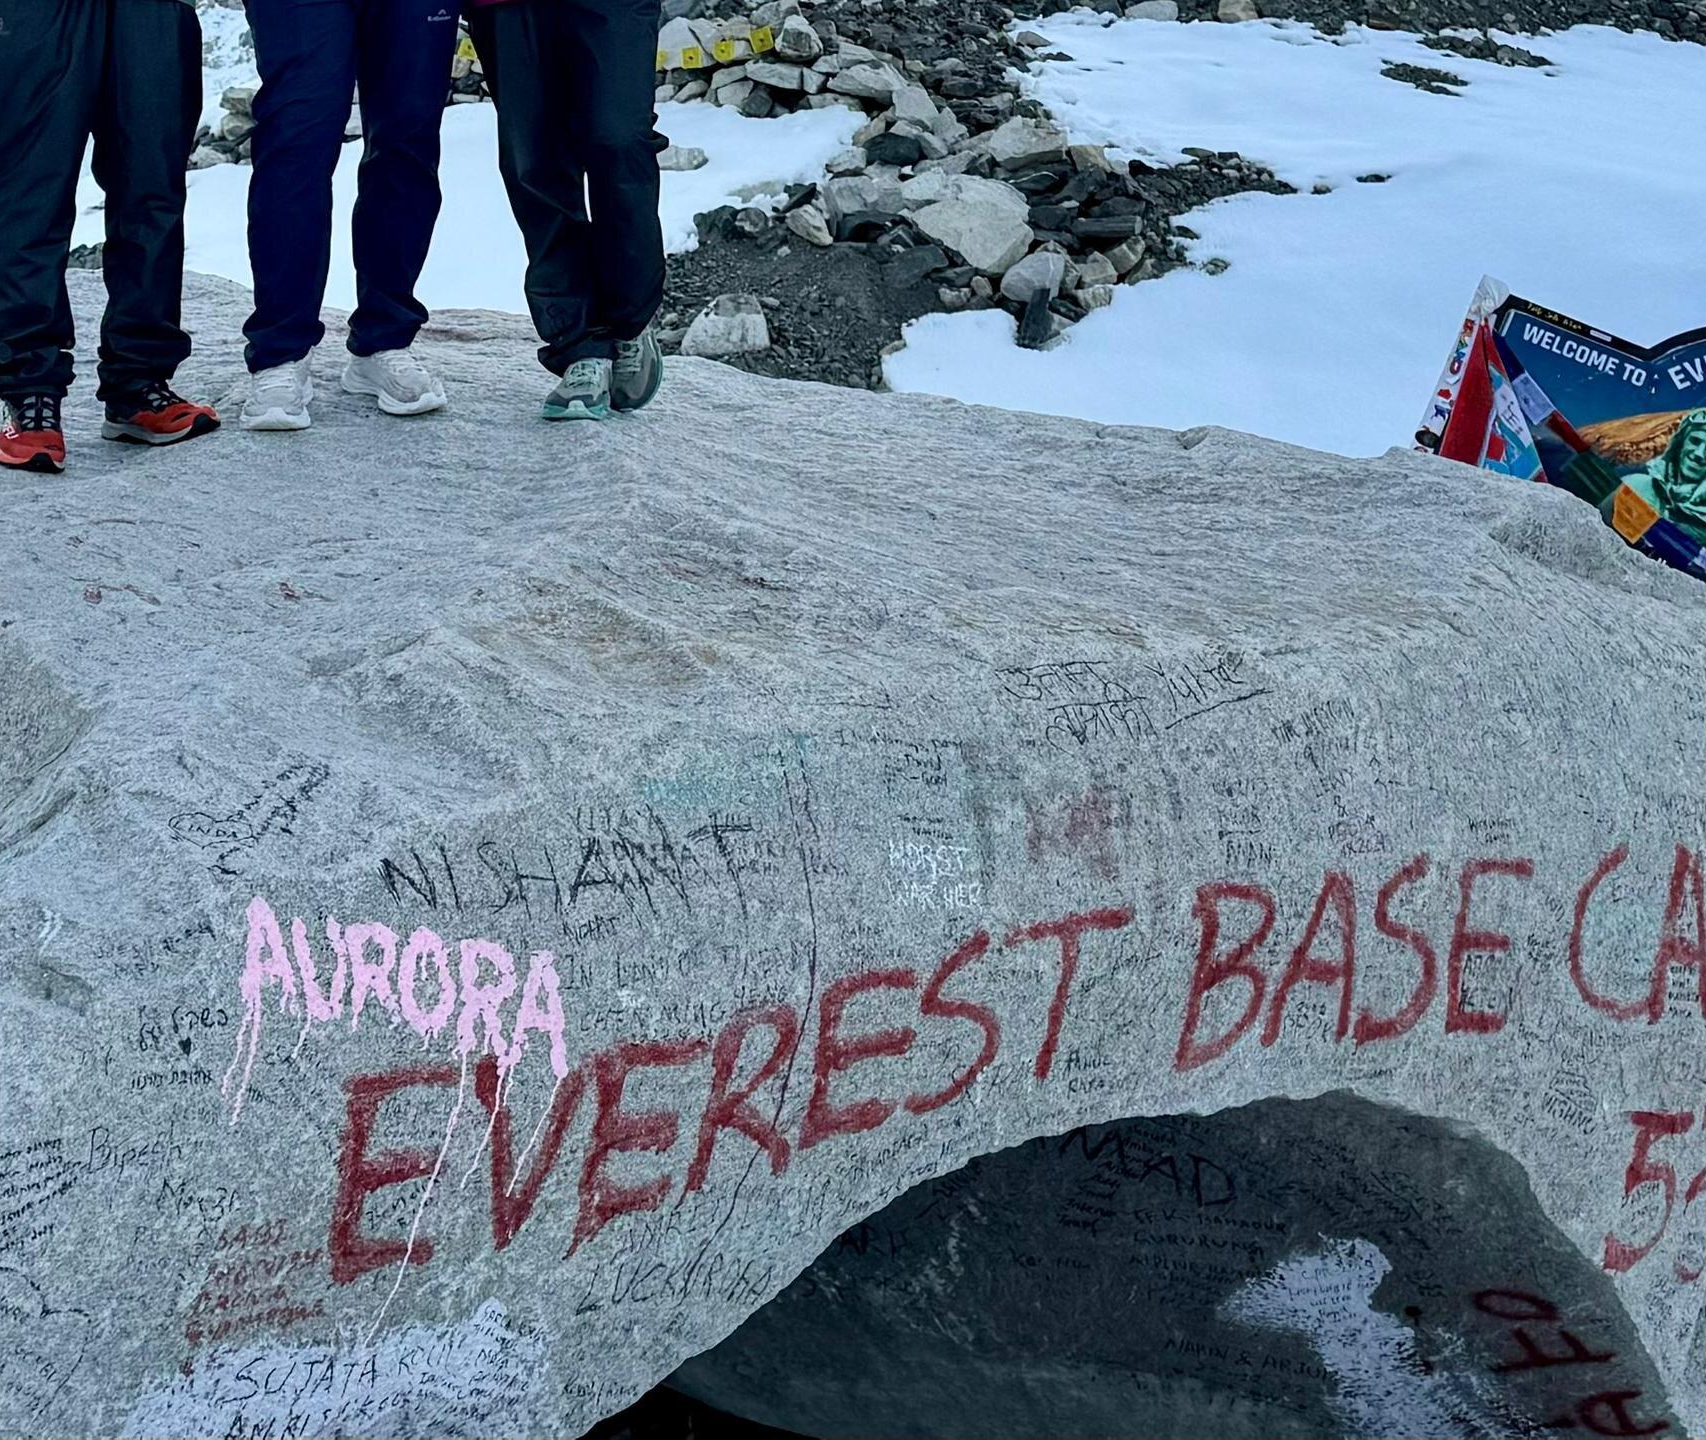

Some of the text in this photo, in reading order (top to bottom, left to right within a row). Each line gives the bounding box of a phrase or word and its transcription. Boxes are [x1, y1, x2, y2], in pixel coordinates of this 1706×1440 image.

[1522, 322, 1616, 377] WELCOME
[1622, 362, 1647, 388] TO
[239, 895, 570, 1080] AURORA
[330, 904, 1135, 1284] EVEREST
[1175, 852, 1535, 1070] BASE
